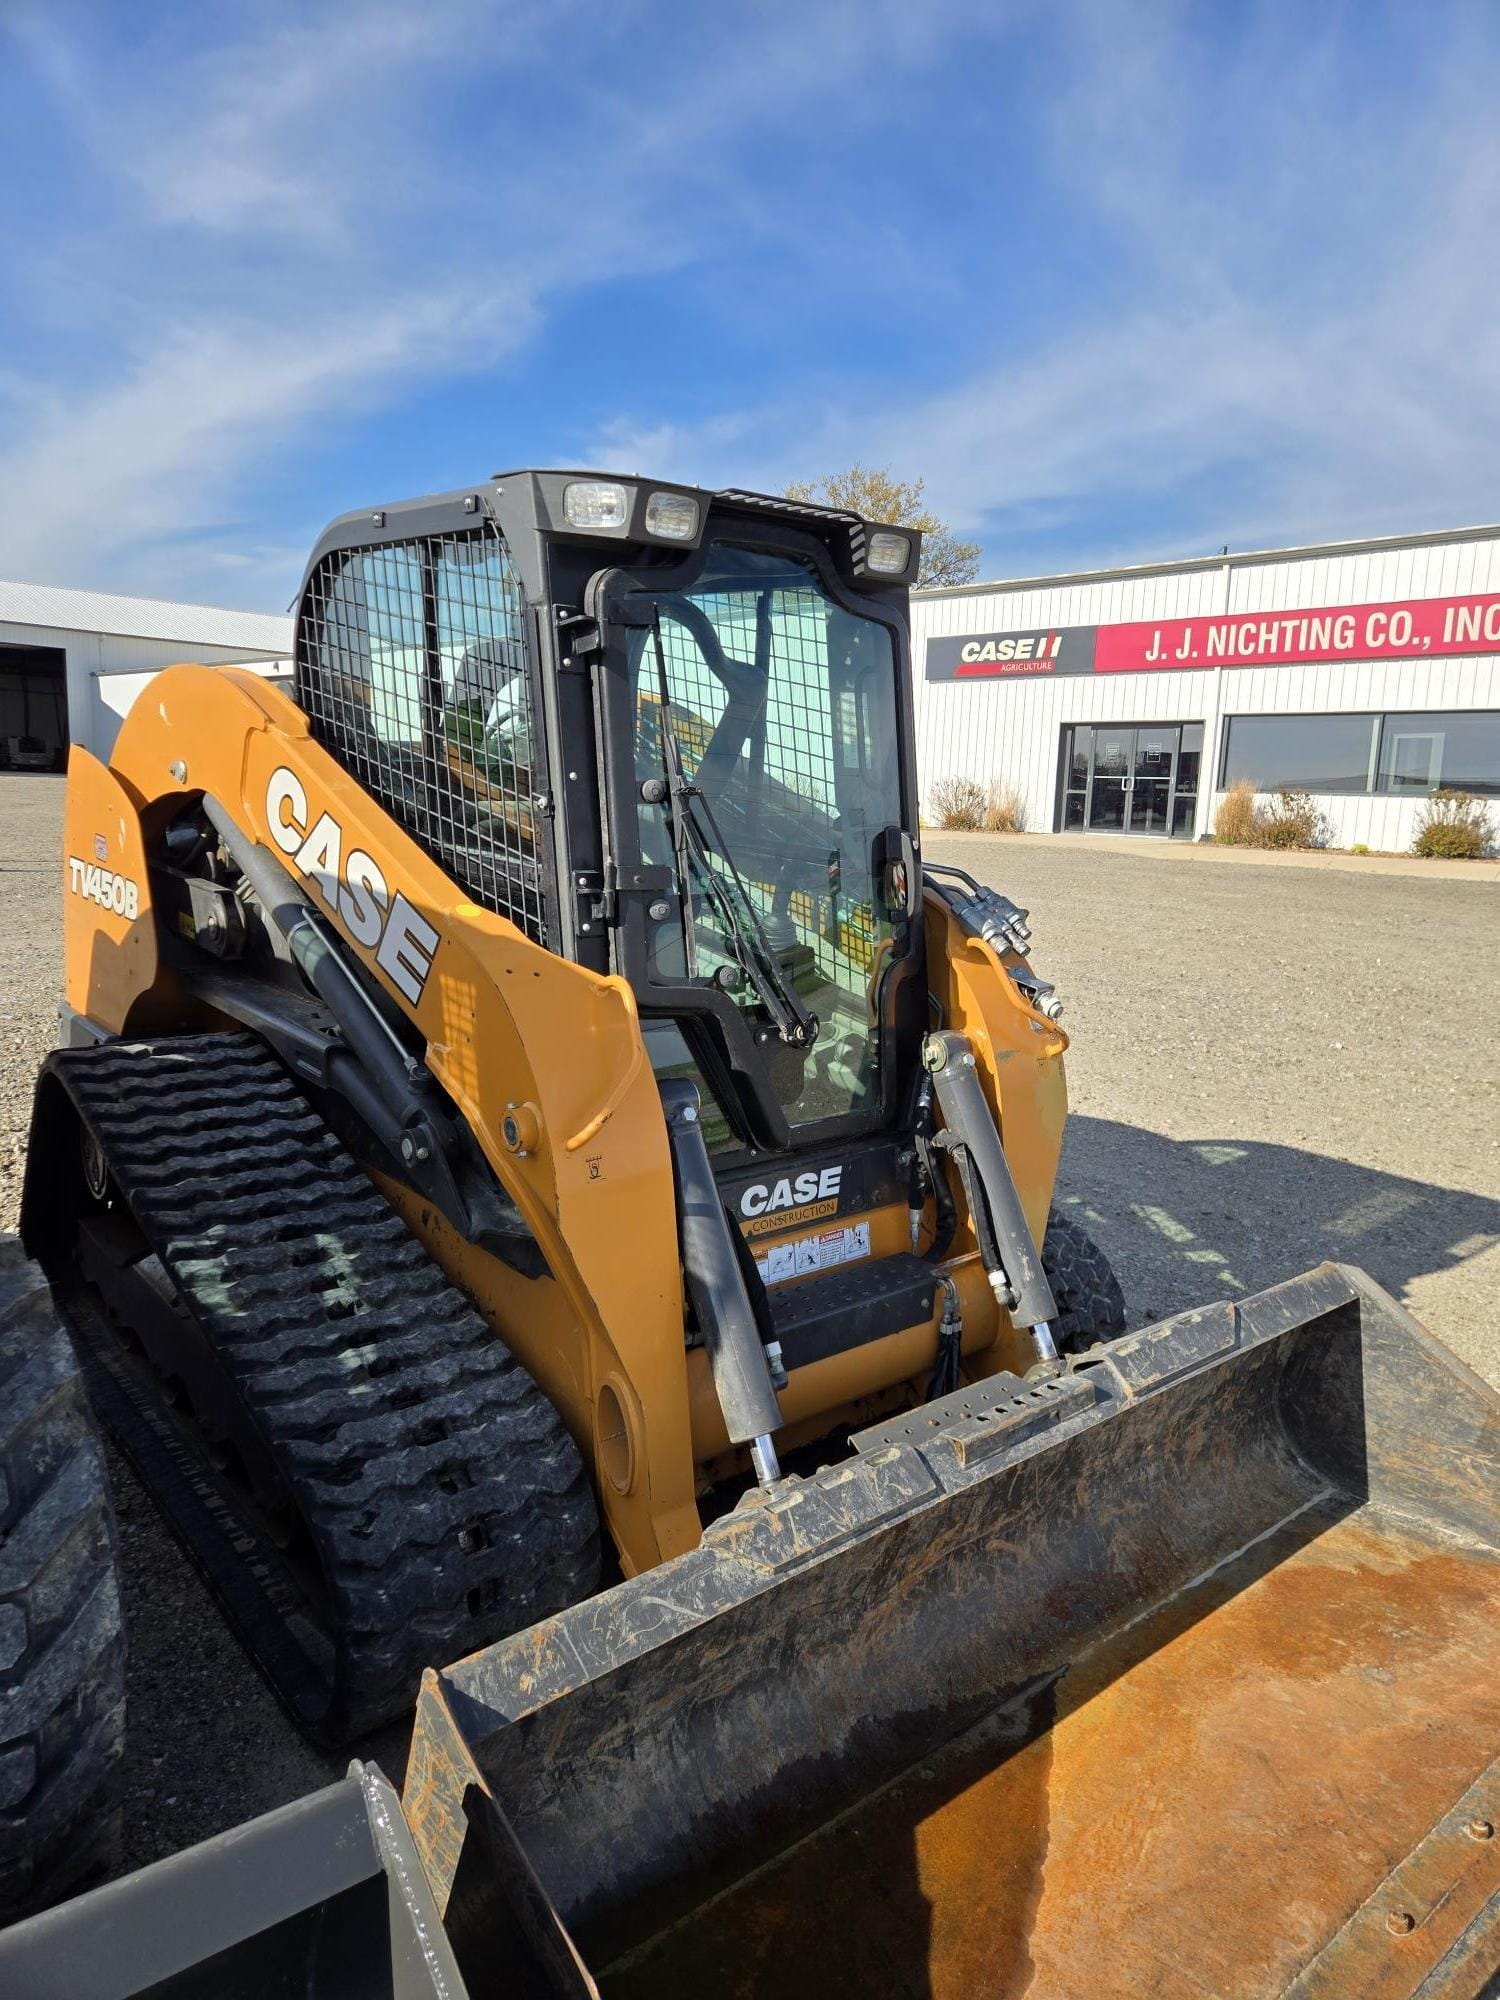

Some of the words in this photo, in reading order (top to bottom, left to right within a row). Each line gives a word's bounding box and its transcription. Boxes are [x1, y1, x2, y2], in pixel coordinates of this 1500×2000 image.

[961, 638, 1035, 663] CASE
[1145, 630, 1167, 662] J.
[1175, 627, 1198, 659] J.
[1206, 614, 1356, 657] NICHTING
[1365, 610, 1431, 650] CO.,
[1000, 661, 1053, 672] AGRICULTURE
[69, 855, 138, 921] TV450B
[266, 765, 441, 1008] CASE
[740, 1165, 843, 1217] CASE
[752, 1201, 835, 1232] CONSTRUCTION
